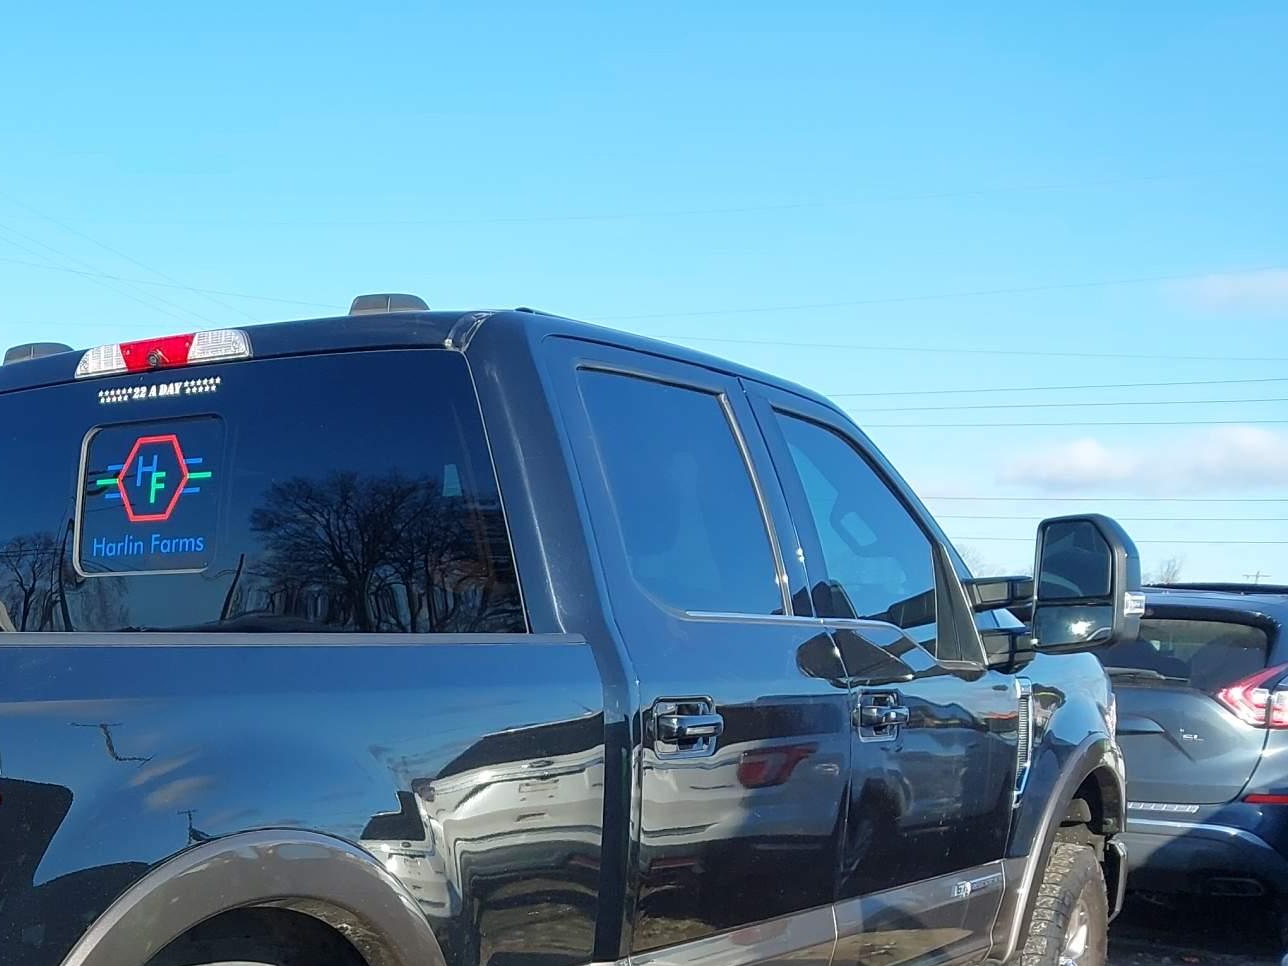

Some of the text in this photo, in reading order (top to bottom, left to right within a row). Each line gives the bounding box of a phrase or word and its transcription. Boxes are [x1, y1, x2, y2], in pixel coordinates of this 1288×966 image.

[132, 382, 183, 399] 22 A DAY
[92, 534, 205, 557] Harlin Farms
